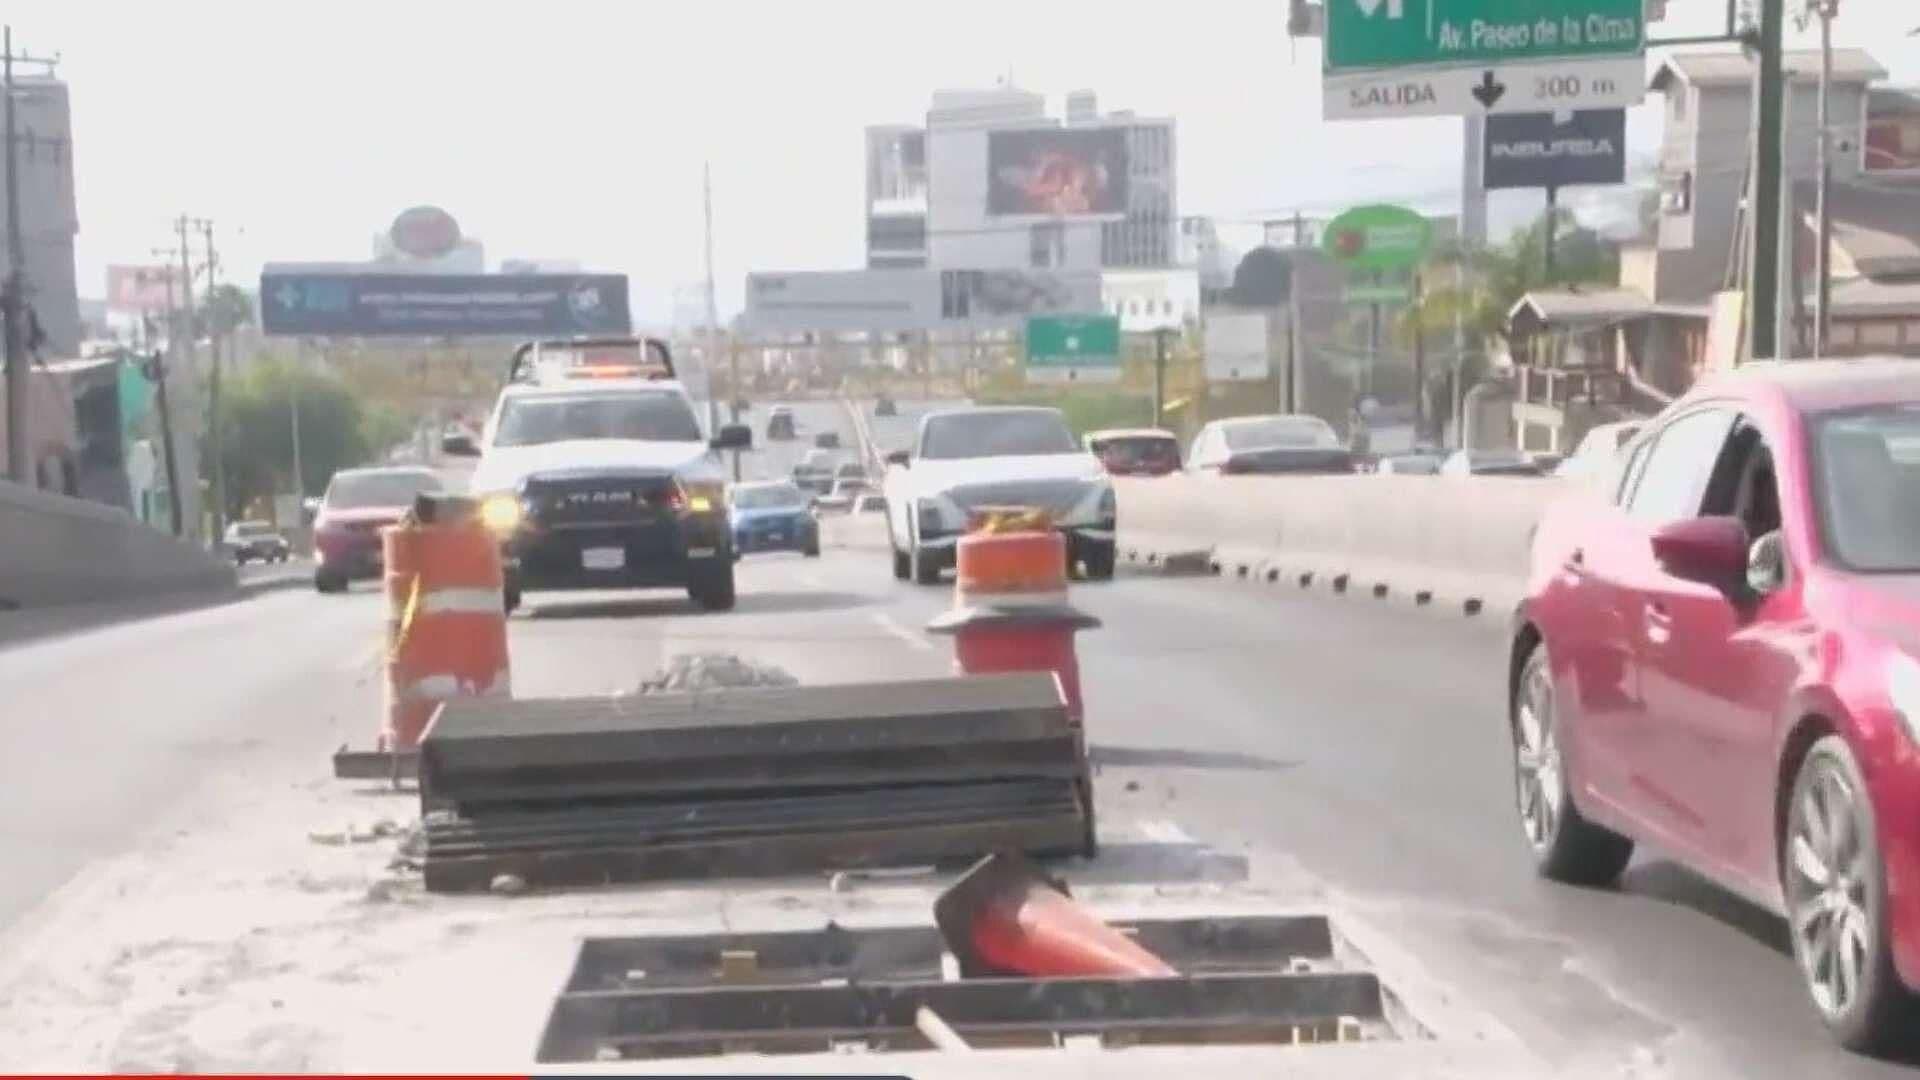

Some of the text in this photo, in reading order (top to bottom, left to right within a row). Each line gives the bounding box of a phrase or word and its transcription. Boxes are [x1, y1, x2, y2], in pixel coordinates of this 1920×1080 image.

[1439, 14, 1636, 49] Av. Paseo de la Cima
[1351, 75, 1616, 108] SALIDA 300 m
